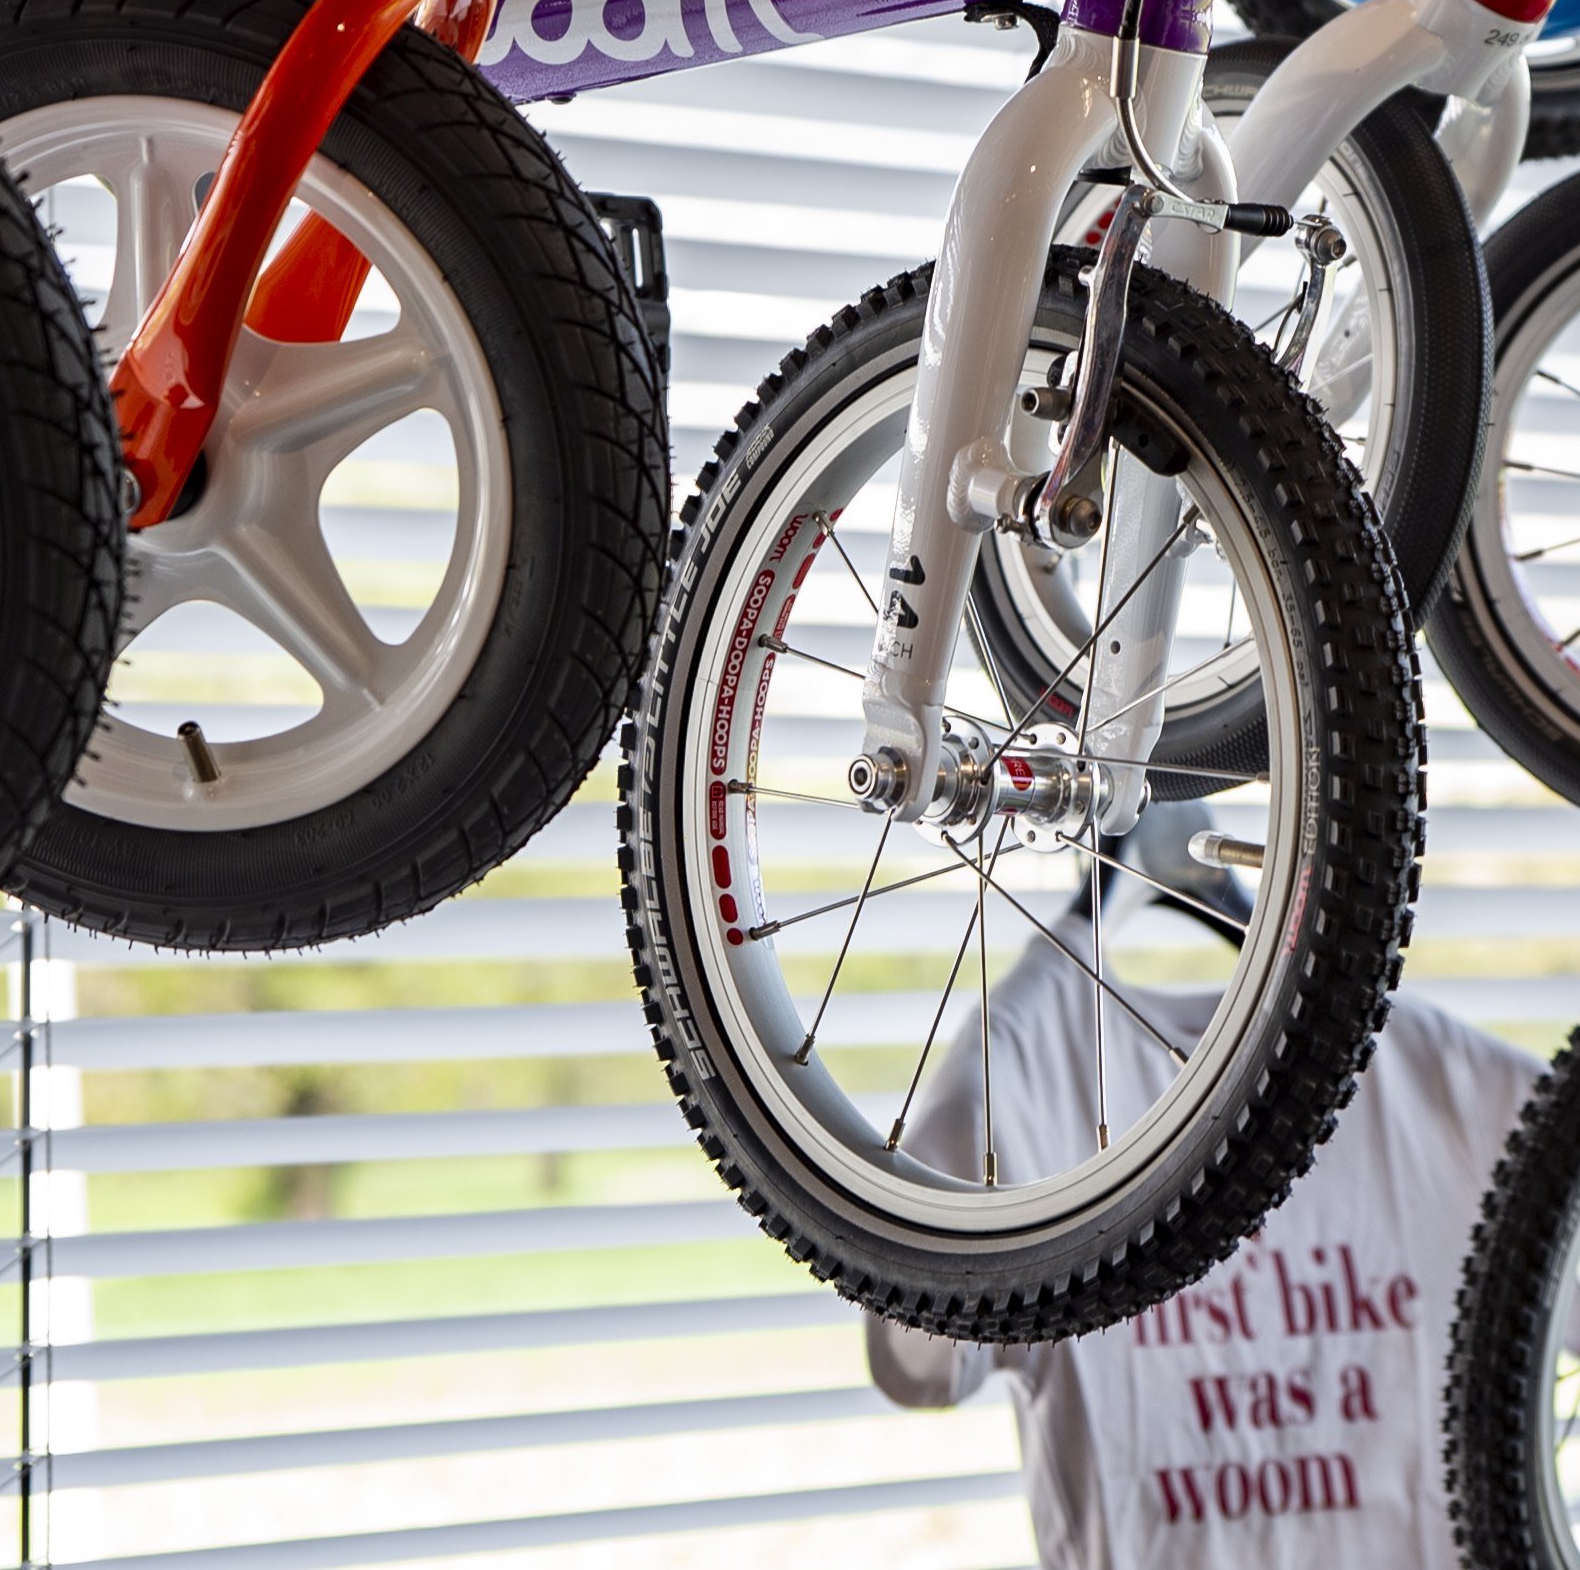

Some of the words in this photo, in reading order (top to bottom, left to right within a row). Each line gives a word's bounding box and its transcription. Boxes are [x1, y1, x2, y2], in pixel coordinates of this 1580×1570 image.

[698, 468, 743, 554] JOE
[770, 513, 808, 562] woom
[883, 555, 926, 629] 14
[646, 555, 699, 728] LITTLE
[711, 573, 772, 770] SOOPA-DOOPA-HOOPS
[1304, 746, 1320, 855] EDITION
[639, 806, 716, 1080] SCHWALBE
[1271, 1242, 1419, 1338] bike
[1188, 1368, 1317, 1435] was
[1338, 1363, 1377, 1423] a
[1153, 1450, 1360, 1526] woom
